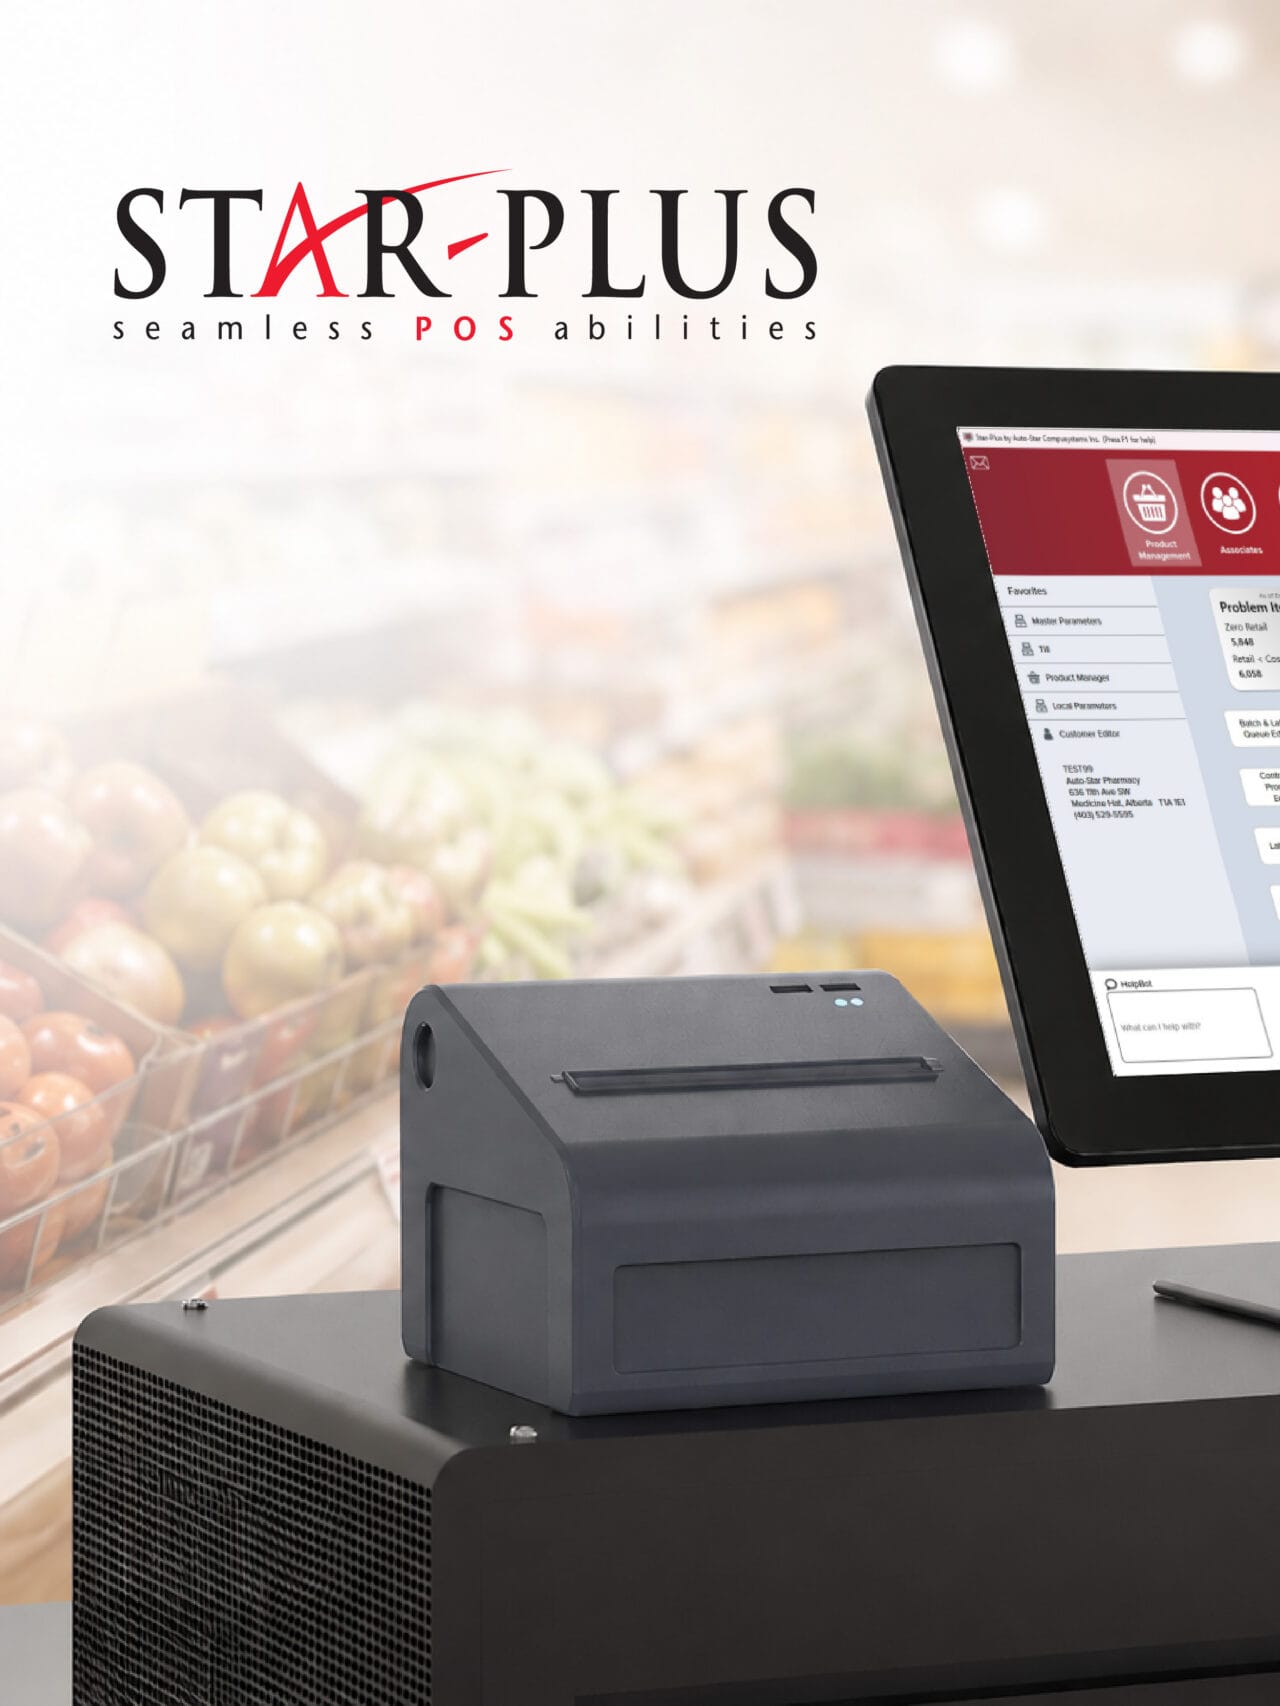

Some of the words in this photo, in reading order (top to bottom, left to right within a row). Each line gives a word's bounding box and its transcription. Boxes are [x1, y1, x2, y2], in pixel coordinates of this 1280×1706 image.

[1146, 540, 1178, 548] Product
[1220, 546, 1263, 554] Associates
[1138, 552, 1191, 560] Management
[1008, 587, 1047, 595] Favorites
[1220, 601, 1268, 612] Problem
[1032, 617, 1057, 625] Master
[1059, 617, 1102, 625] Parameters
[1225, 623, 1243, 631] Zero
[1245, 623, 1268, 631] Retail
[1233, 655, 1255, 663] Retail
[1046, 674, 1075, 682] Product
[1076, 674, 1110, 683] Manager
[1052, 702, 1072, 710] Local
[1074, 702, 1117, 710] Parameters
[1239, 719, 1261, 728] Batch
[1059, 730, 1095, 738] Customer
[1097, 730, 1120, 738] Editor
[1243, 730, 1268, 739] Queue
[1062, 765, 1093, 773] TEST99
[1102, 777, 1140, 785] Pharmacy
[1125, 799, 1153, 807] Alberta
